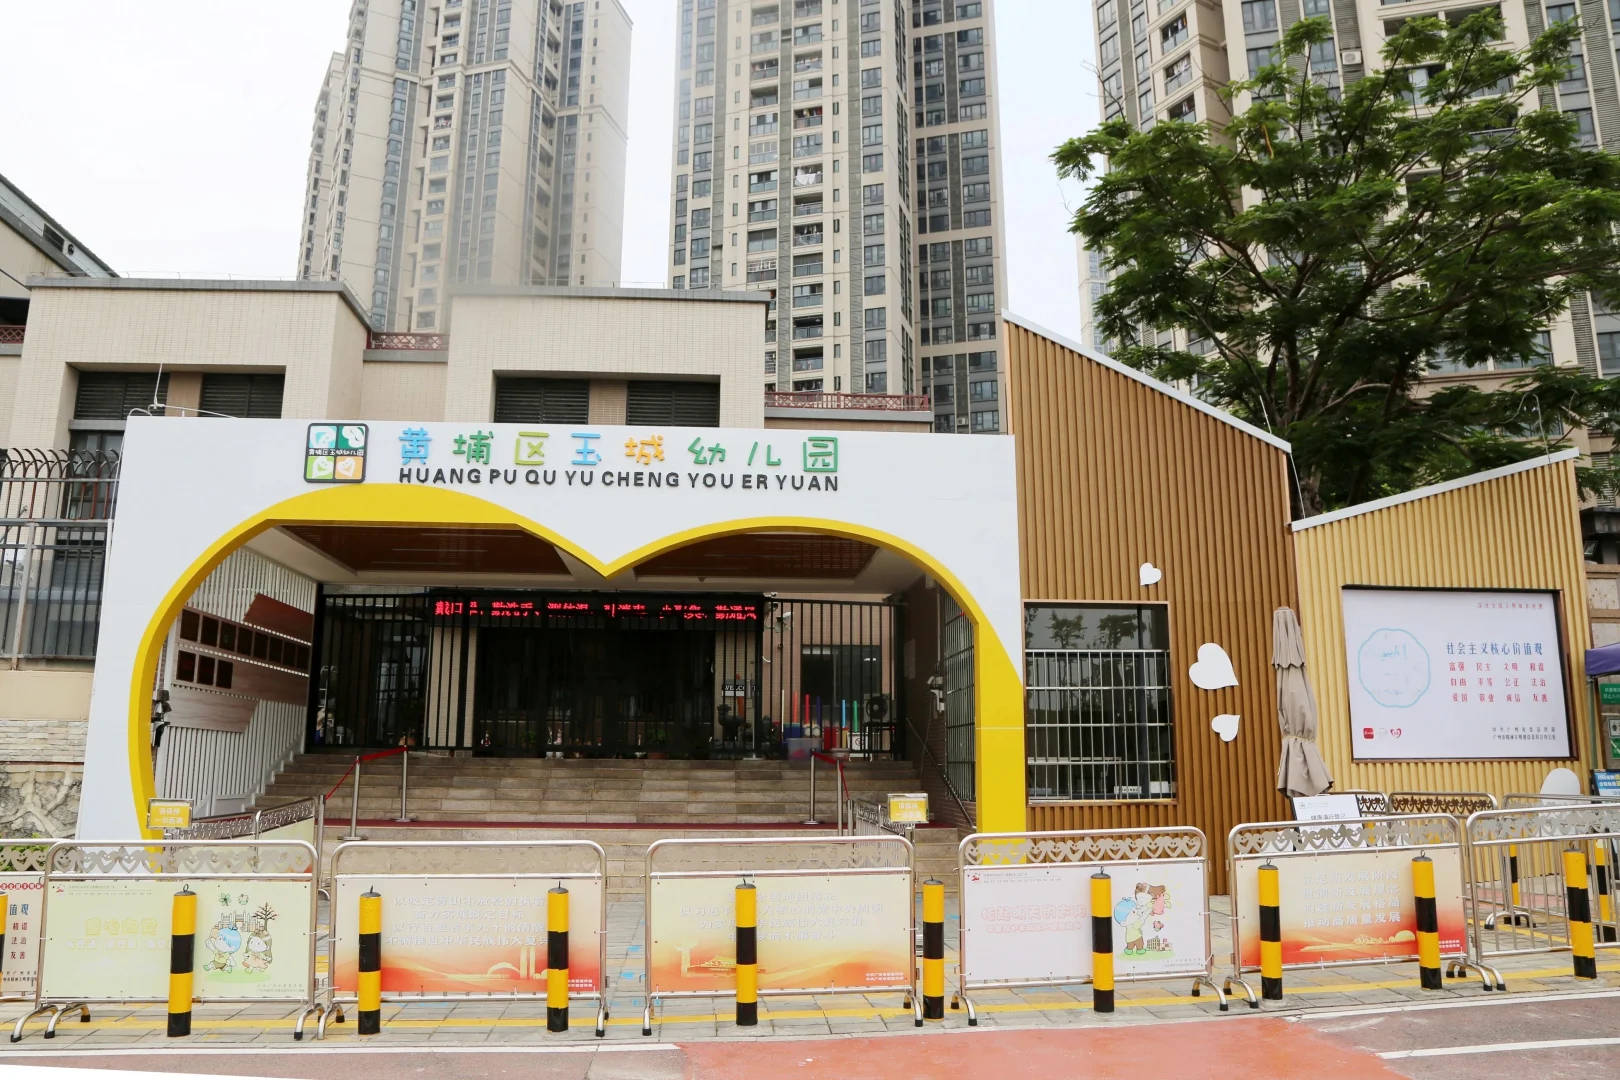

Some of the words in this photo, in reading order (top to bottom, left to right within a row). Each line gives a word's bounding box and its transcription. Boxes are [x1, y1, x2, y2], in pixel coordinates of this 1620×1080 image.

[399, 427, 839, 473] 黄埔区玉城幼儿园
[399, 467, 482, 485] HUANG
[489, 468, 517, 485] PU
[525, 469, 557, 486] QU
[565, 470, 594, 487] YU
[601, 470, 679, 488] CHENG
[687, 472, 734, 490] YOU
[741, 474, 768, 490] ER
[775, 474, 838, 492] YUAN
[1446, 642, 1543, 656] 社会主义核心价值观
[1449, 661, 1465, 672] 富强
[1476, 662, 1491, 671] 民主
[1504, 662, 1518, 671] 文明
[1529, 662, 1544, 672] 和谐
[1450, 678, 1467, 687] 自由
[1478, 677, 1493, 687] 平等
[1505, 677, 1519, 687] 公正
[1531, 677, 1546, 687] 法治
[1452, 692, 1468, 702] 爱国
[1479, 693, 1494, 702] 敬业
[1506, 693, 1521, 702] 诚信
[1532, 693, 1548, 702] 友善
[1301, 868, 1399, 885] 立足新发展阶段
[1303, 883, 1400, 900] 贯彻新发展理念
[394, 895, 546, 907] 以咬定青山不放松的执着
[1302, 897, 1401, 914] 构建新发展格局
[414, 908, 525, 920] 奋力实现既定目标
[680, 903, 883, 917] 以习近平为核心的党中央周围
[700, 917, 863, 931] 为实现华民族伟大复兴的
[1304, 911, 1401, 928] 推动高质量发展
[393, 922, 547, 933] 以行百里者半九十的清醒
[11, 936, 27, 945] 法治
[10, 951, 26, 960] 友善
